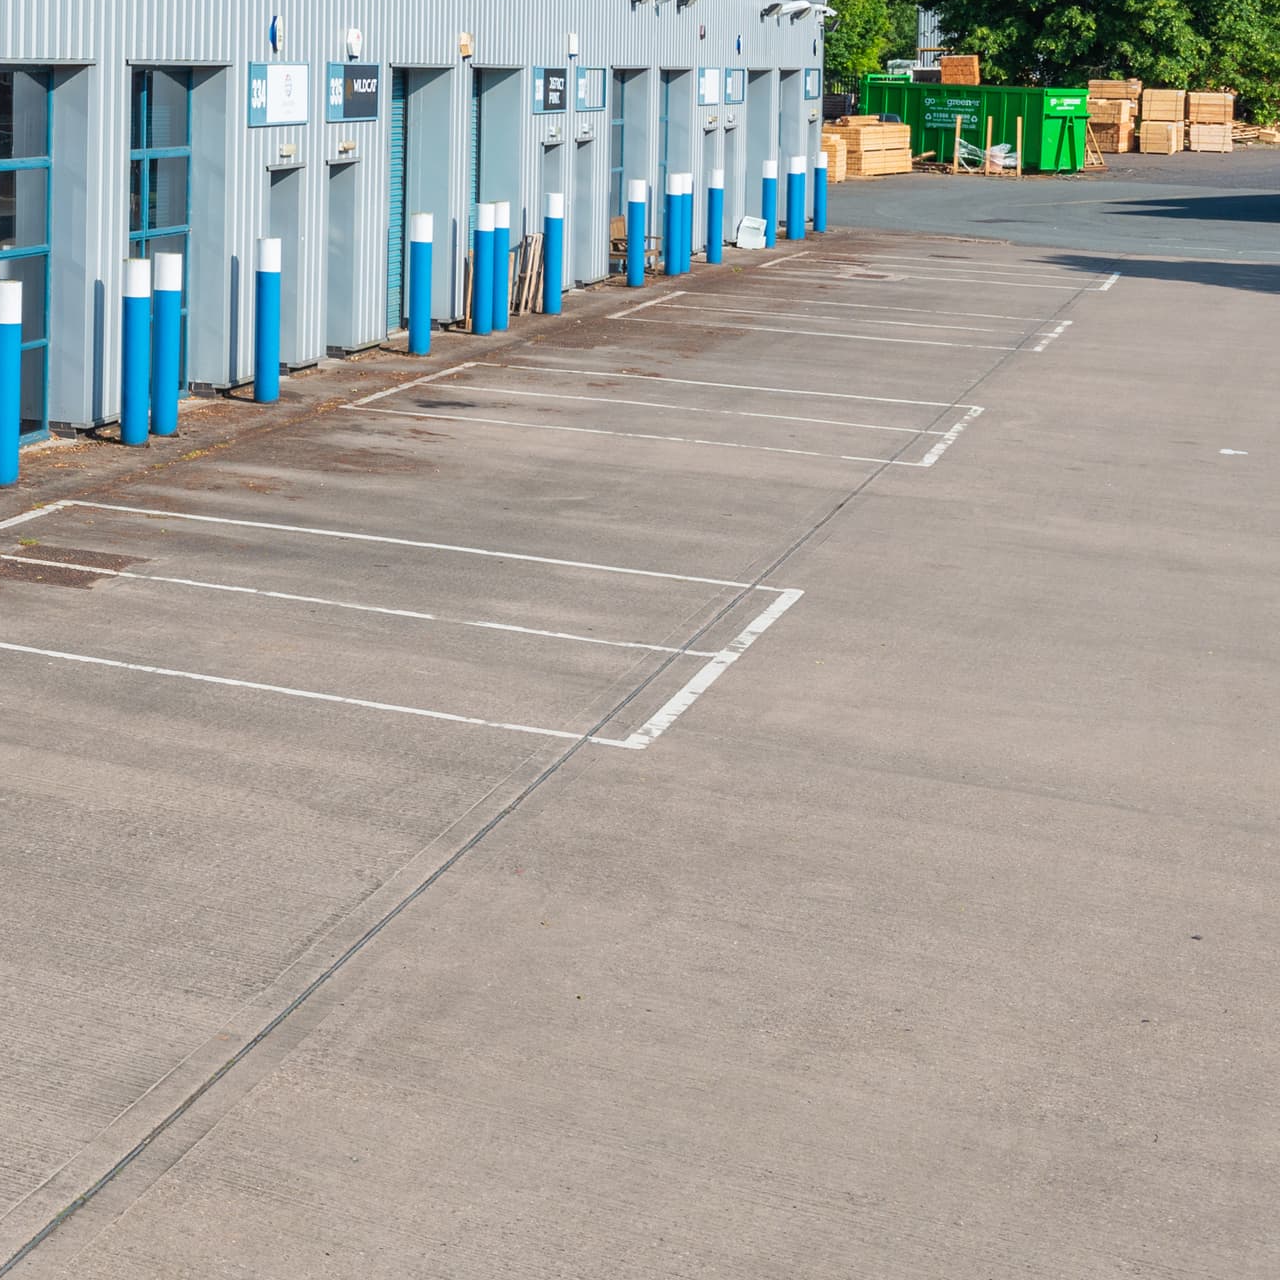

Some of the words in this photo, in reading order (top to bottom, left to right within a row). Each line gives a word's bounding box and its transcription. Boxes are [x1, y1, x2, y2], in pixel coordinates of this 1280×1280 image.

[251, 79, 265, 108] 334
[330, 78, 343, 105] 335
[353, 78, 378, 93] WILDCAT
